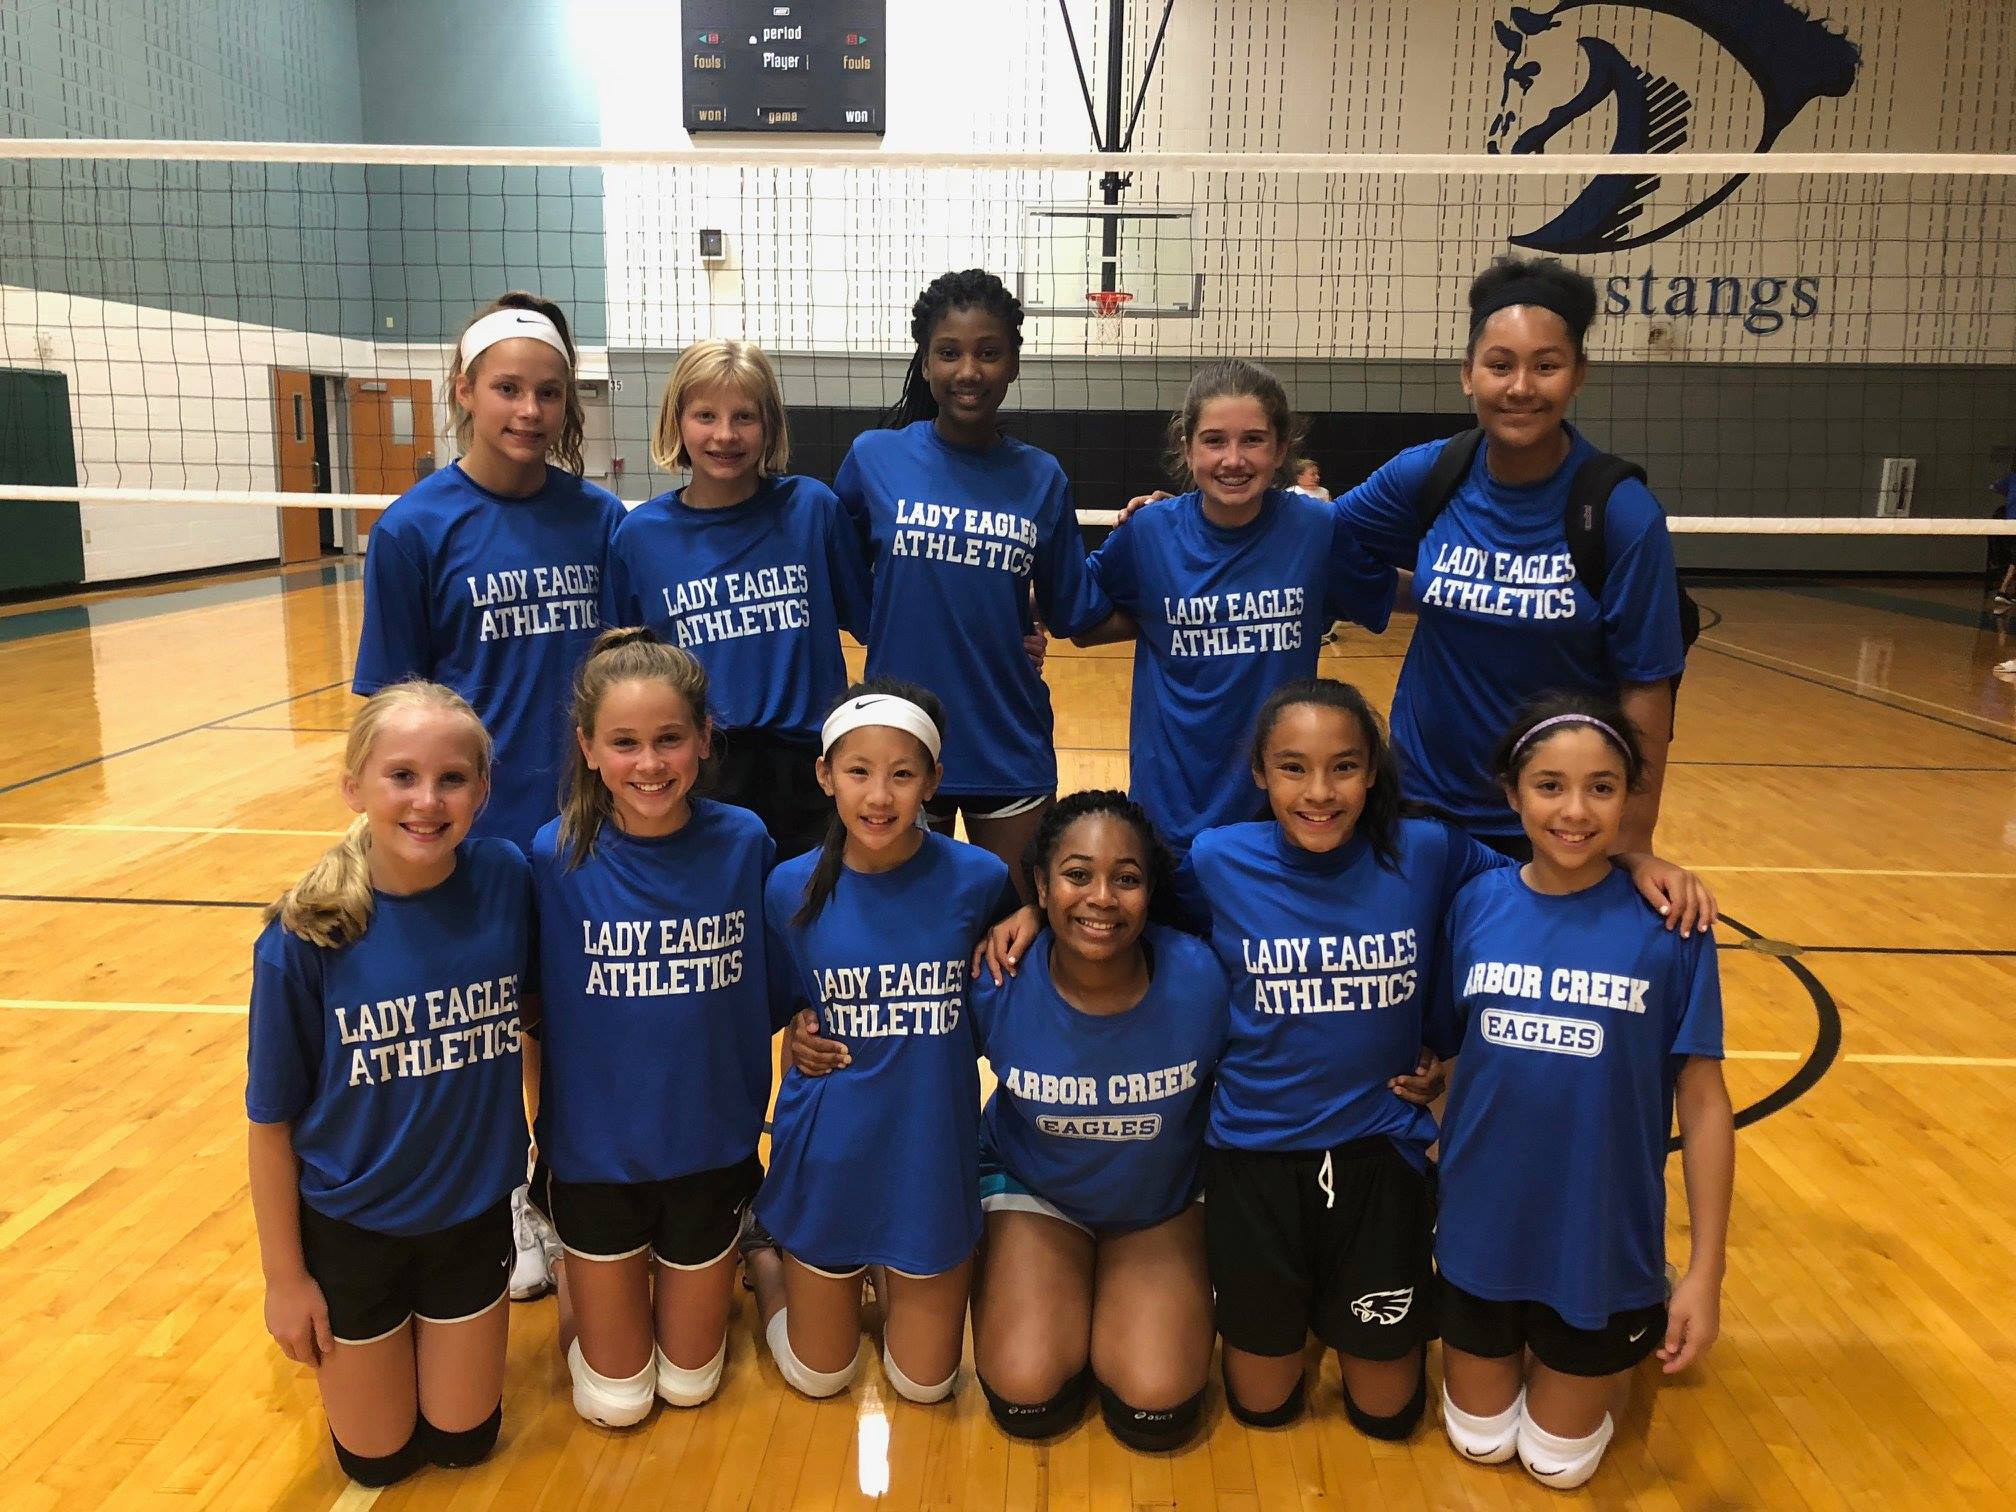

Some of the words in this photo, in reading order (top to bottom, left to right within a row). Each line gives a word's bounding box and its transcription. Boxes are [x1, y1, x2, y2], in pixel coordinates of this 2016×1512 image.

[763, 26, 802, 42] period
[694, 54, 721, 69] fouls
[763, 52, 800, 71] Player
[843, 55, 871, 70] fouls
[699, 108, 722, 121] won
[768, 110, 798, 125] game
[845, 109, 868, 123] won
[1606, 265, 1821, 335] stangs
[610, 380, 623, 392] 35
[896, 498, 953, 530] LADY
[964, 510, 1038, 549] EAGLES
[892, 529, 1035, 577] ATHLETICS
[1432, 543, 1490, 580] LADY
[1494, 552, 1577, 584] EAGLES
[467, 569, 528, 608] LADY
[662, 577, 718, 618] LADY
[724, 564, 809, 600] EAGLES
[1163, 595, 1220, 626] LADY
[1225, 587, 1304, 622] EAGLES
[1422, 576, 1577, 620] ATHLETICS
[675, 598, 811, 649] ATHLETICS
[1170, 621, 1303, 658] ATHLETICS
[583, 920, 653, 957] LADY
[659, 910, 746, 955] EAGLES
[1242, 937, 1311, 975] LADY
[1318, 928, 1418, 972] EAGLES
[585, 950, 744, 998] ATHLETICS
[879, 959, 966, 998] EAGLES
[1255, 969, 1417, 1016] ATHLETICS
[1463, 962, 1542, 1000] ARBOR
[1549, 967, 1650, 1015] CREEK
[334, 995, 418, 1045] LADY
[824, 998, 962, 1038] ATHLETICS
[1487, 1015, 1597, 1050] EAGLES
[348, 1016, 521, 1087] ATHLETICS
[1005, 1066, 1098, 1106] ARBOR
[1107, 1059, 1199, 1104] CREEK
[1042, 1117, 1158, 1139] EAGLES
